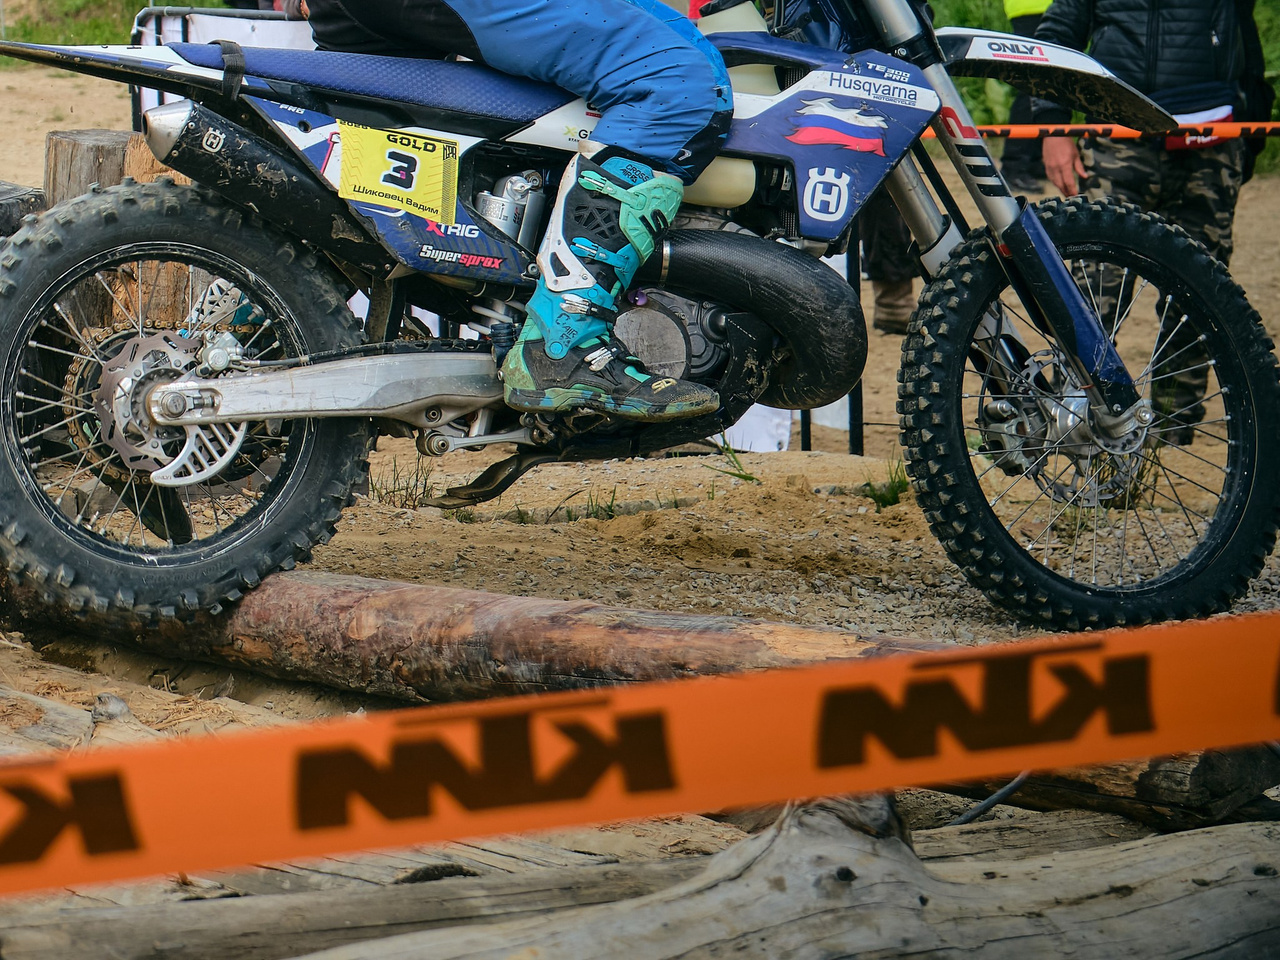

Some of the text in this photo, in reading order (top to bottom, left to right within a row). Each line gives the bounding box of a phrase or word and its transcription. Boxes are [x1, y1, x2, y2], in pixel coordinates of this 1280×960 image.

[987, 42, 1045, 56] ONLY1
[829, 73, 918, 101] Husqvarna
[883, 73, 910, 83] PRO
[872, 94, 917, 107] MOTORCYCLES
[386, 134, 437, 153] GOLD
[380, 149, 421, 191] 3
[625, 163, 650, 182] CROSS
[352, 184, 440, 215] Шиковец Вадим
[419, 244, 504, 270] Supersprox
